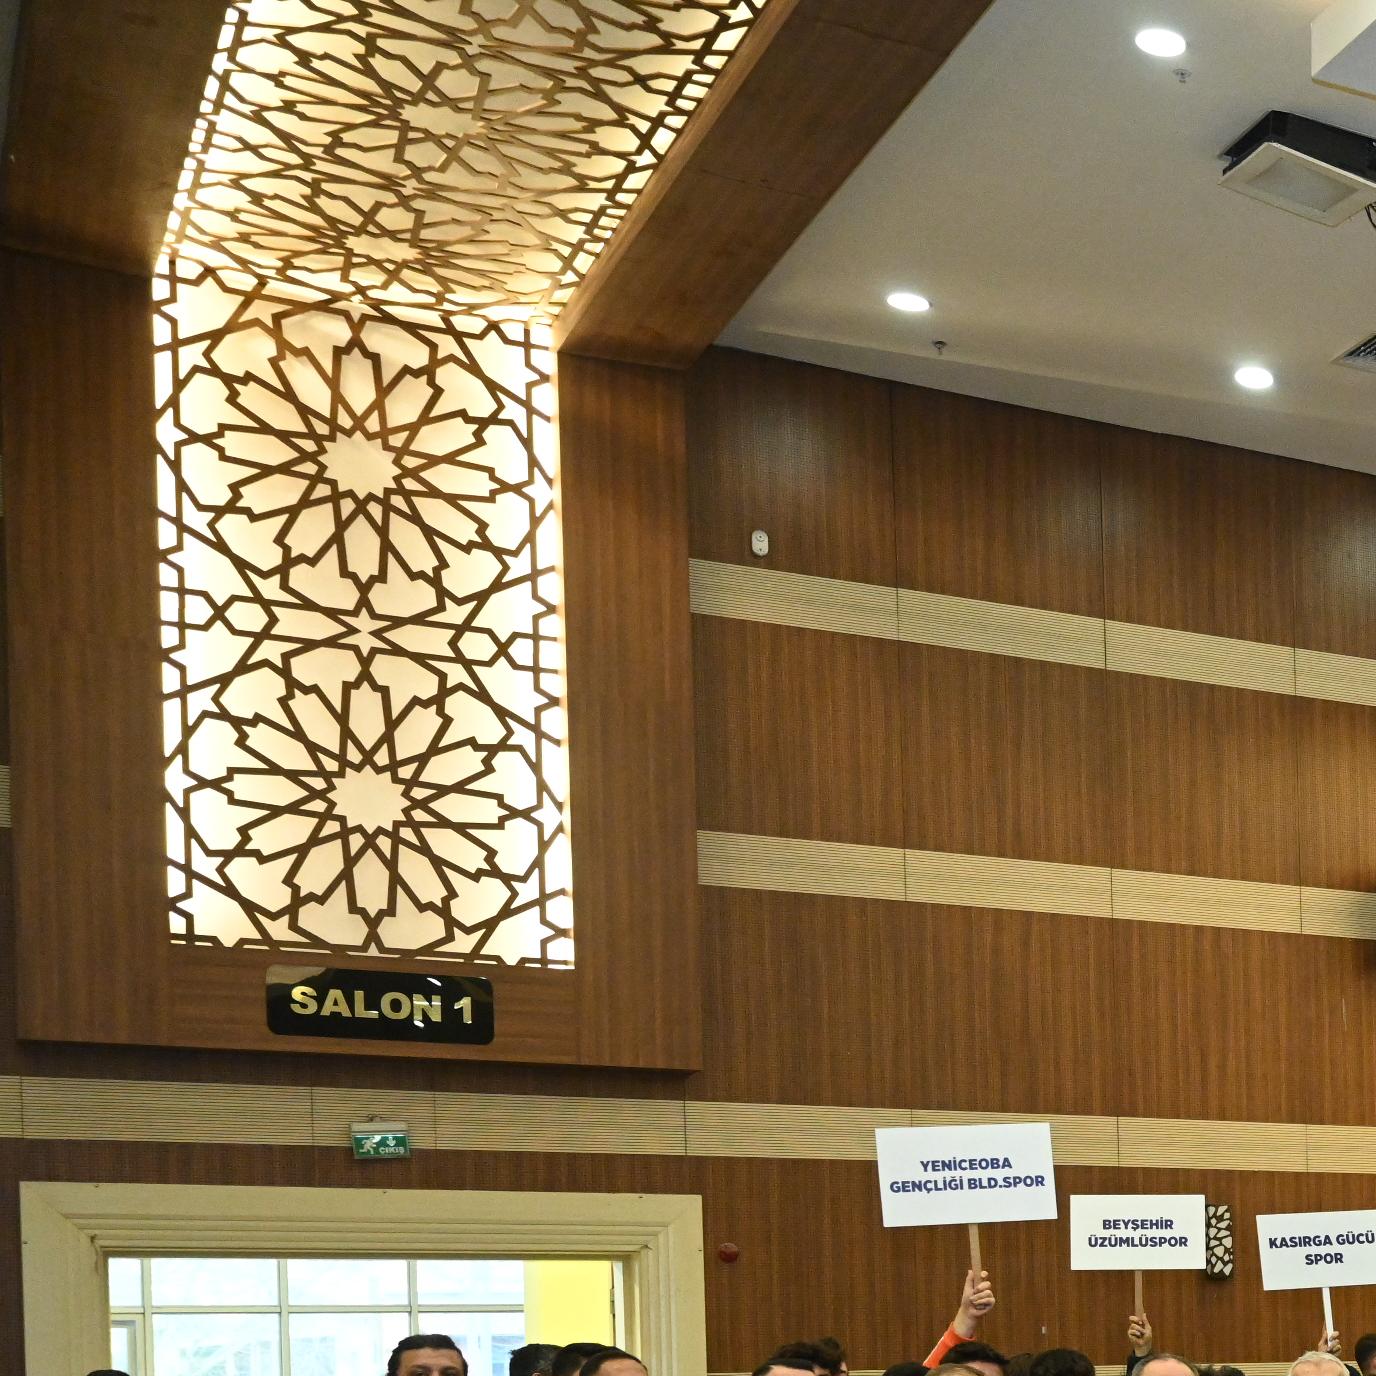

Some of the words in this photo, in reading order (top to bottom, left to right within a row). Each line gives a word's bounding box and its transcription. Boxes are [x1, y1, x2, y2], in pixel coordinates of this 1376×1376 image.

[290, 985, 442, 1023] SALON
[454, 996, 473, 1025] 1
[920, 1156, 1013, 1172] YENİCEOBA
[889, 1176, 964, 1194] GENÇLİĞİ
[967, 1175, 1046, 1190] BLD.SPOR
[1102, 1216, 1174, 1232] BEYŞEHİR
[1088, 1234, 1189, 1248] ÜZÜMLÜSPOR
[1268, 1235, 1334, 1249] KASIRGA
[1335, 1231, 1376, 1246] GÜCÜ
[1304, 1252, 1344, 1265] SPOR
